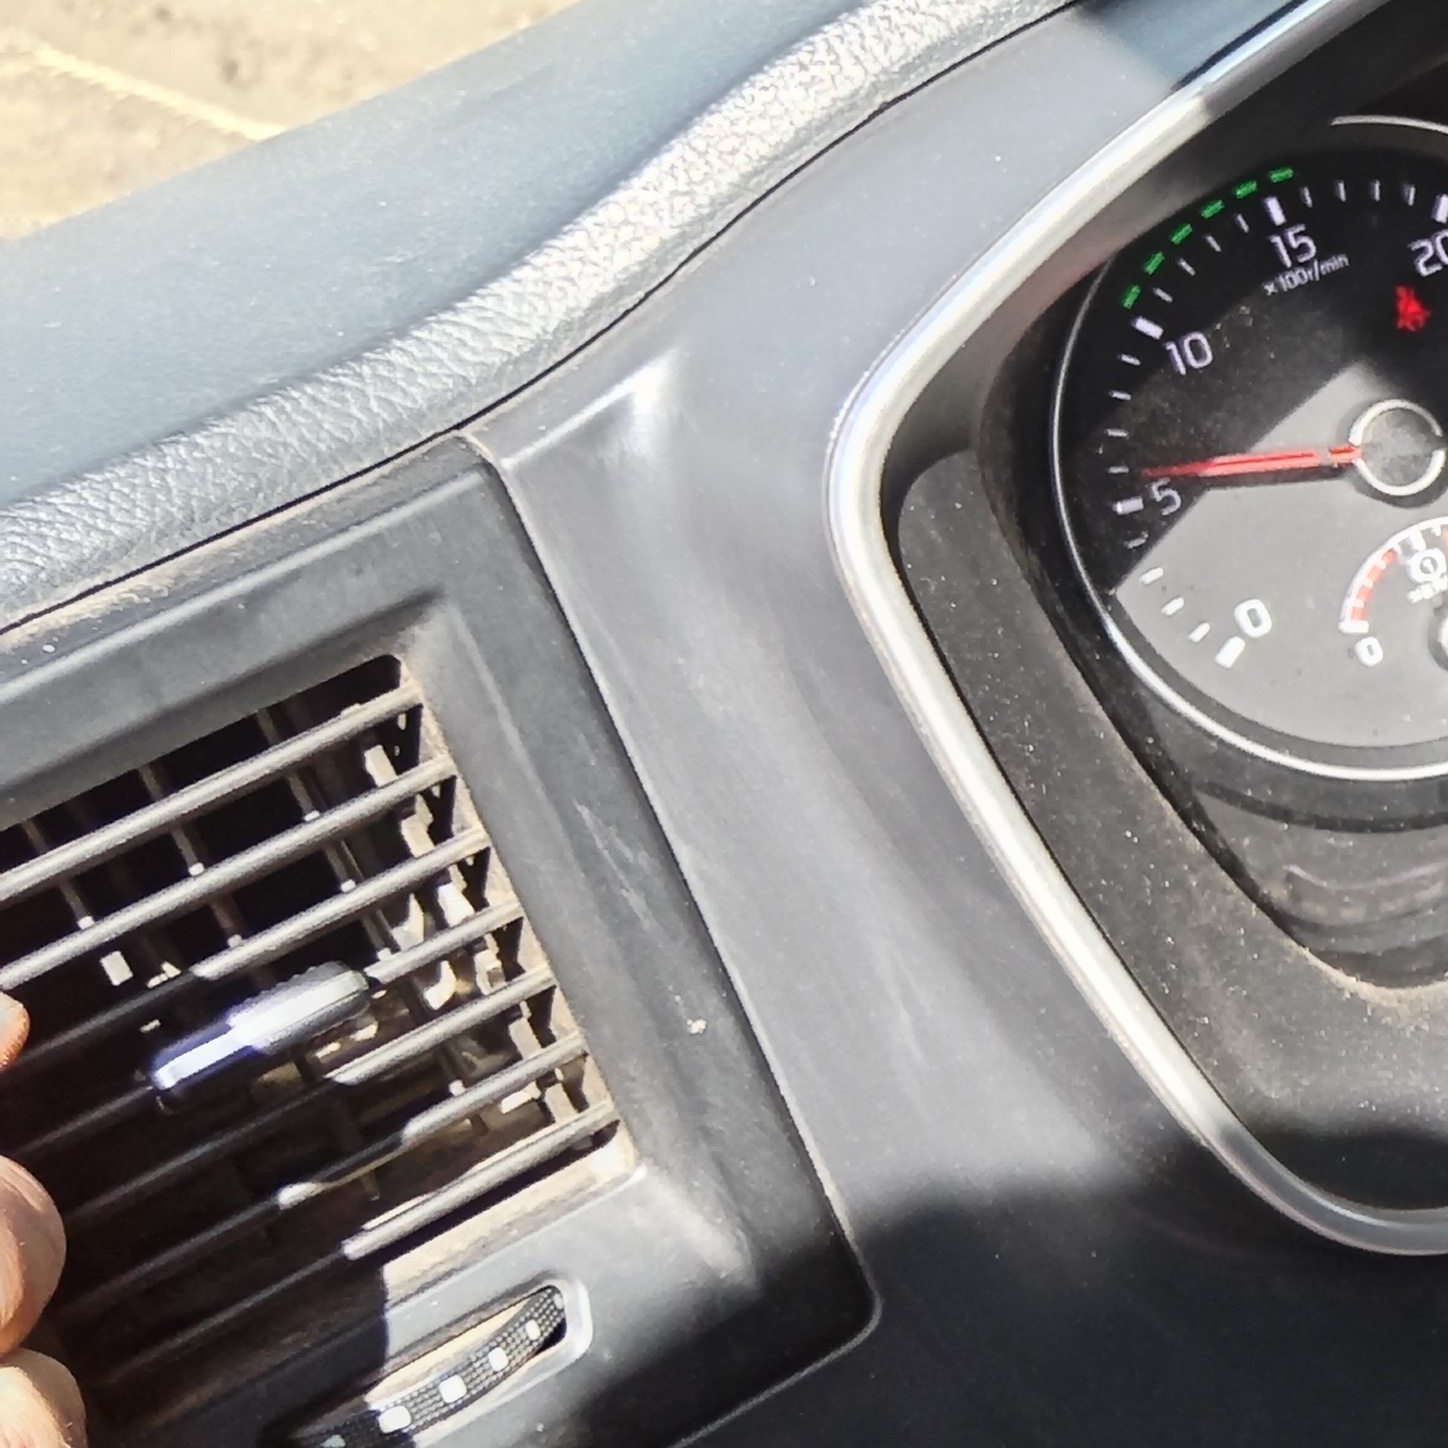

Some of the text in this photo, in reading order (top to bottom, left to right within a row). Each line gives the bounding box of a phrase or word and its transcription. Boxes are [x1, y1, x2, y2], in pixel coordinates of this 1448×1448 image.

[1269, 223, 1318, 269] 15
[1166, 331, 1213, 376] 10
[1148, 478, 1183, 516] 5
[1233, 598, 1274, 640] 0
[1354, 634, 1384, 667] 0
